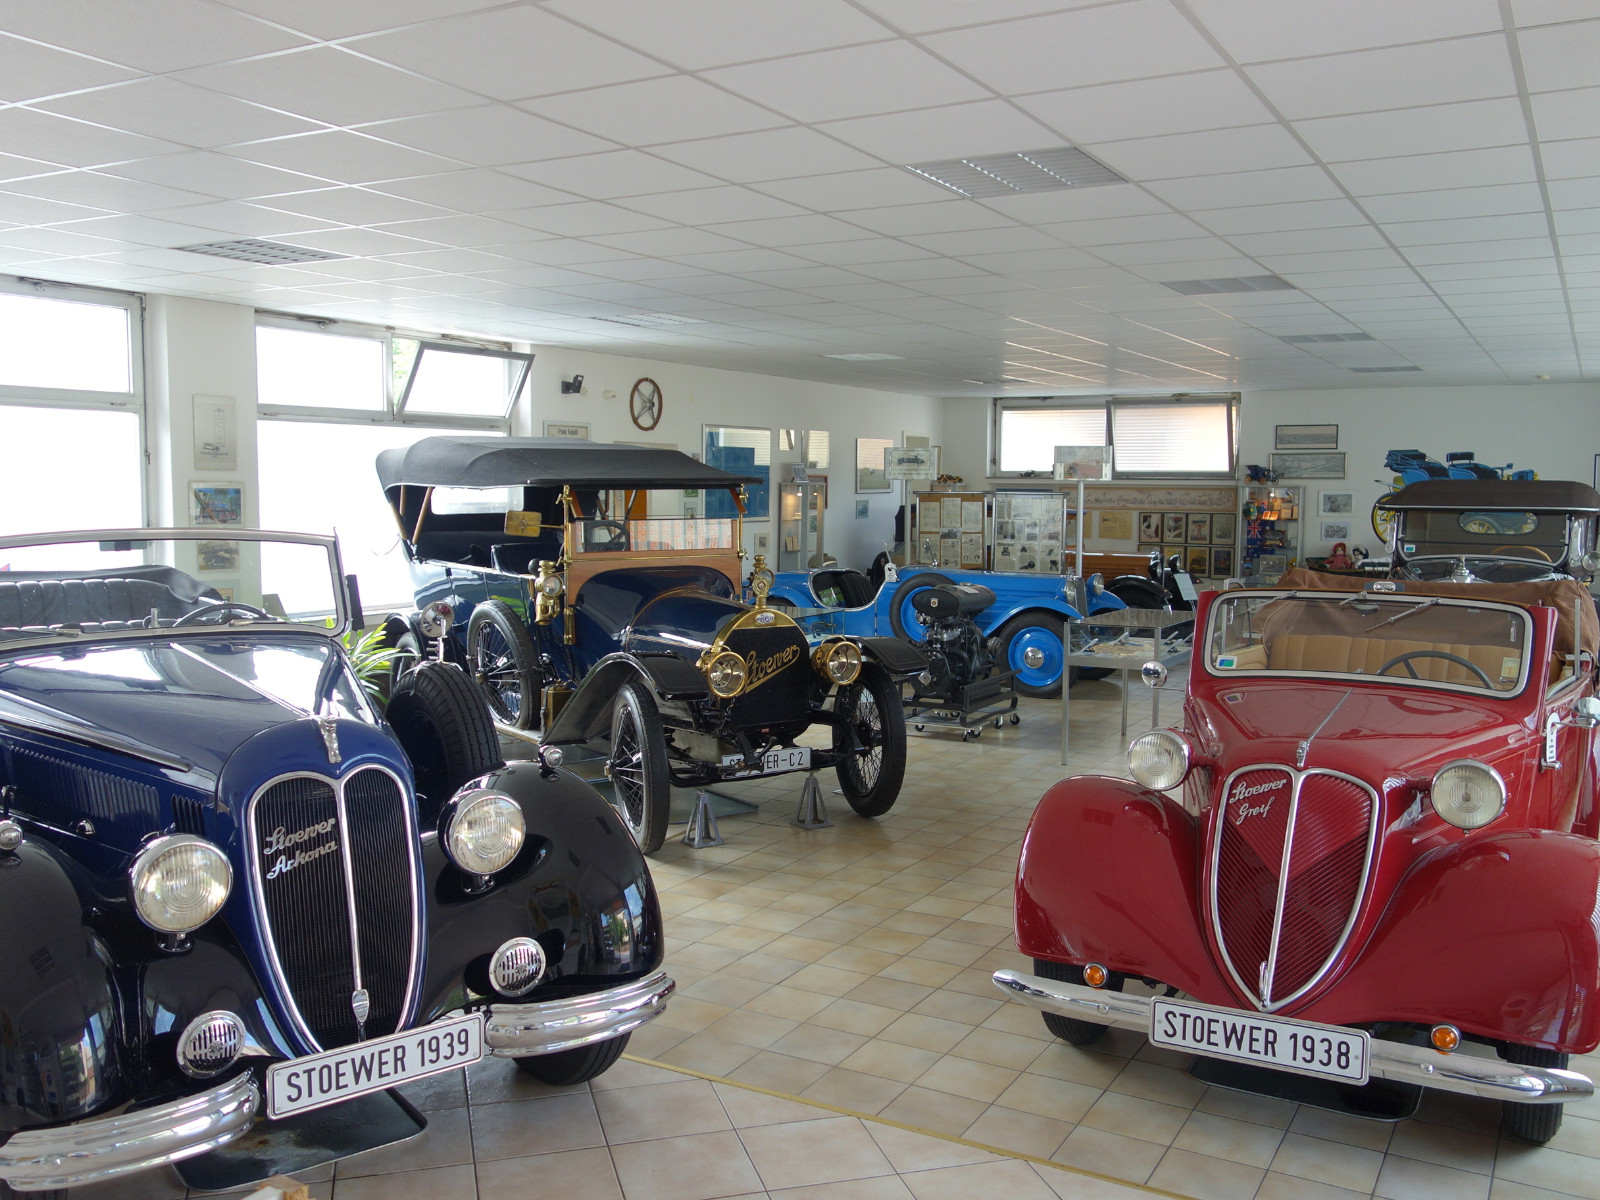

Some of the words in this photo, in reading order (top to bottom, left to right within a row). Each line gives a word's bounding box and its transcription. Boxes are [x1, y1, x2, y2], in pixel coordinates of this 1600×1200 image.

[1229, 779, 1287, 804] Stoewer
[1236, 796, 1275, 825] Greif
[263, 817, 336, 855] Stoewer
[266, 840, 338, 879] Arkona
[1163, 1010, 1277, 1058] STOEWER
[1289, 1032, 1351, 1070] 1938
[286, 1044, 407, 1103] STOEWER
[416, 1028, 469, 1067] 1939
